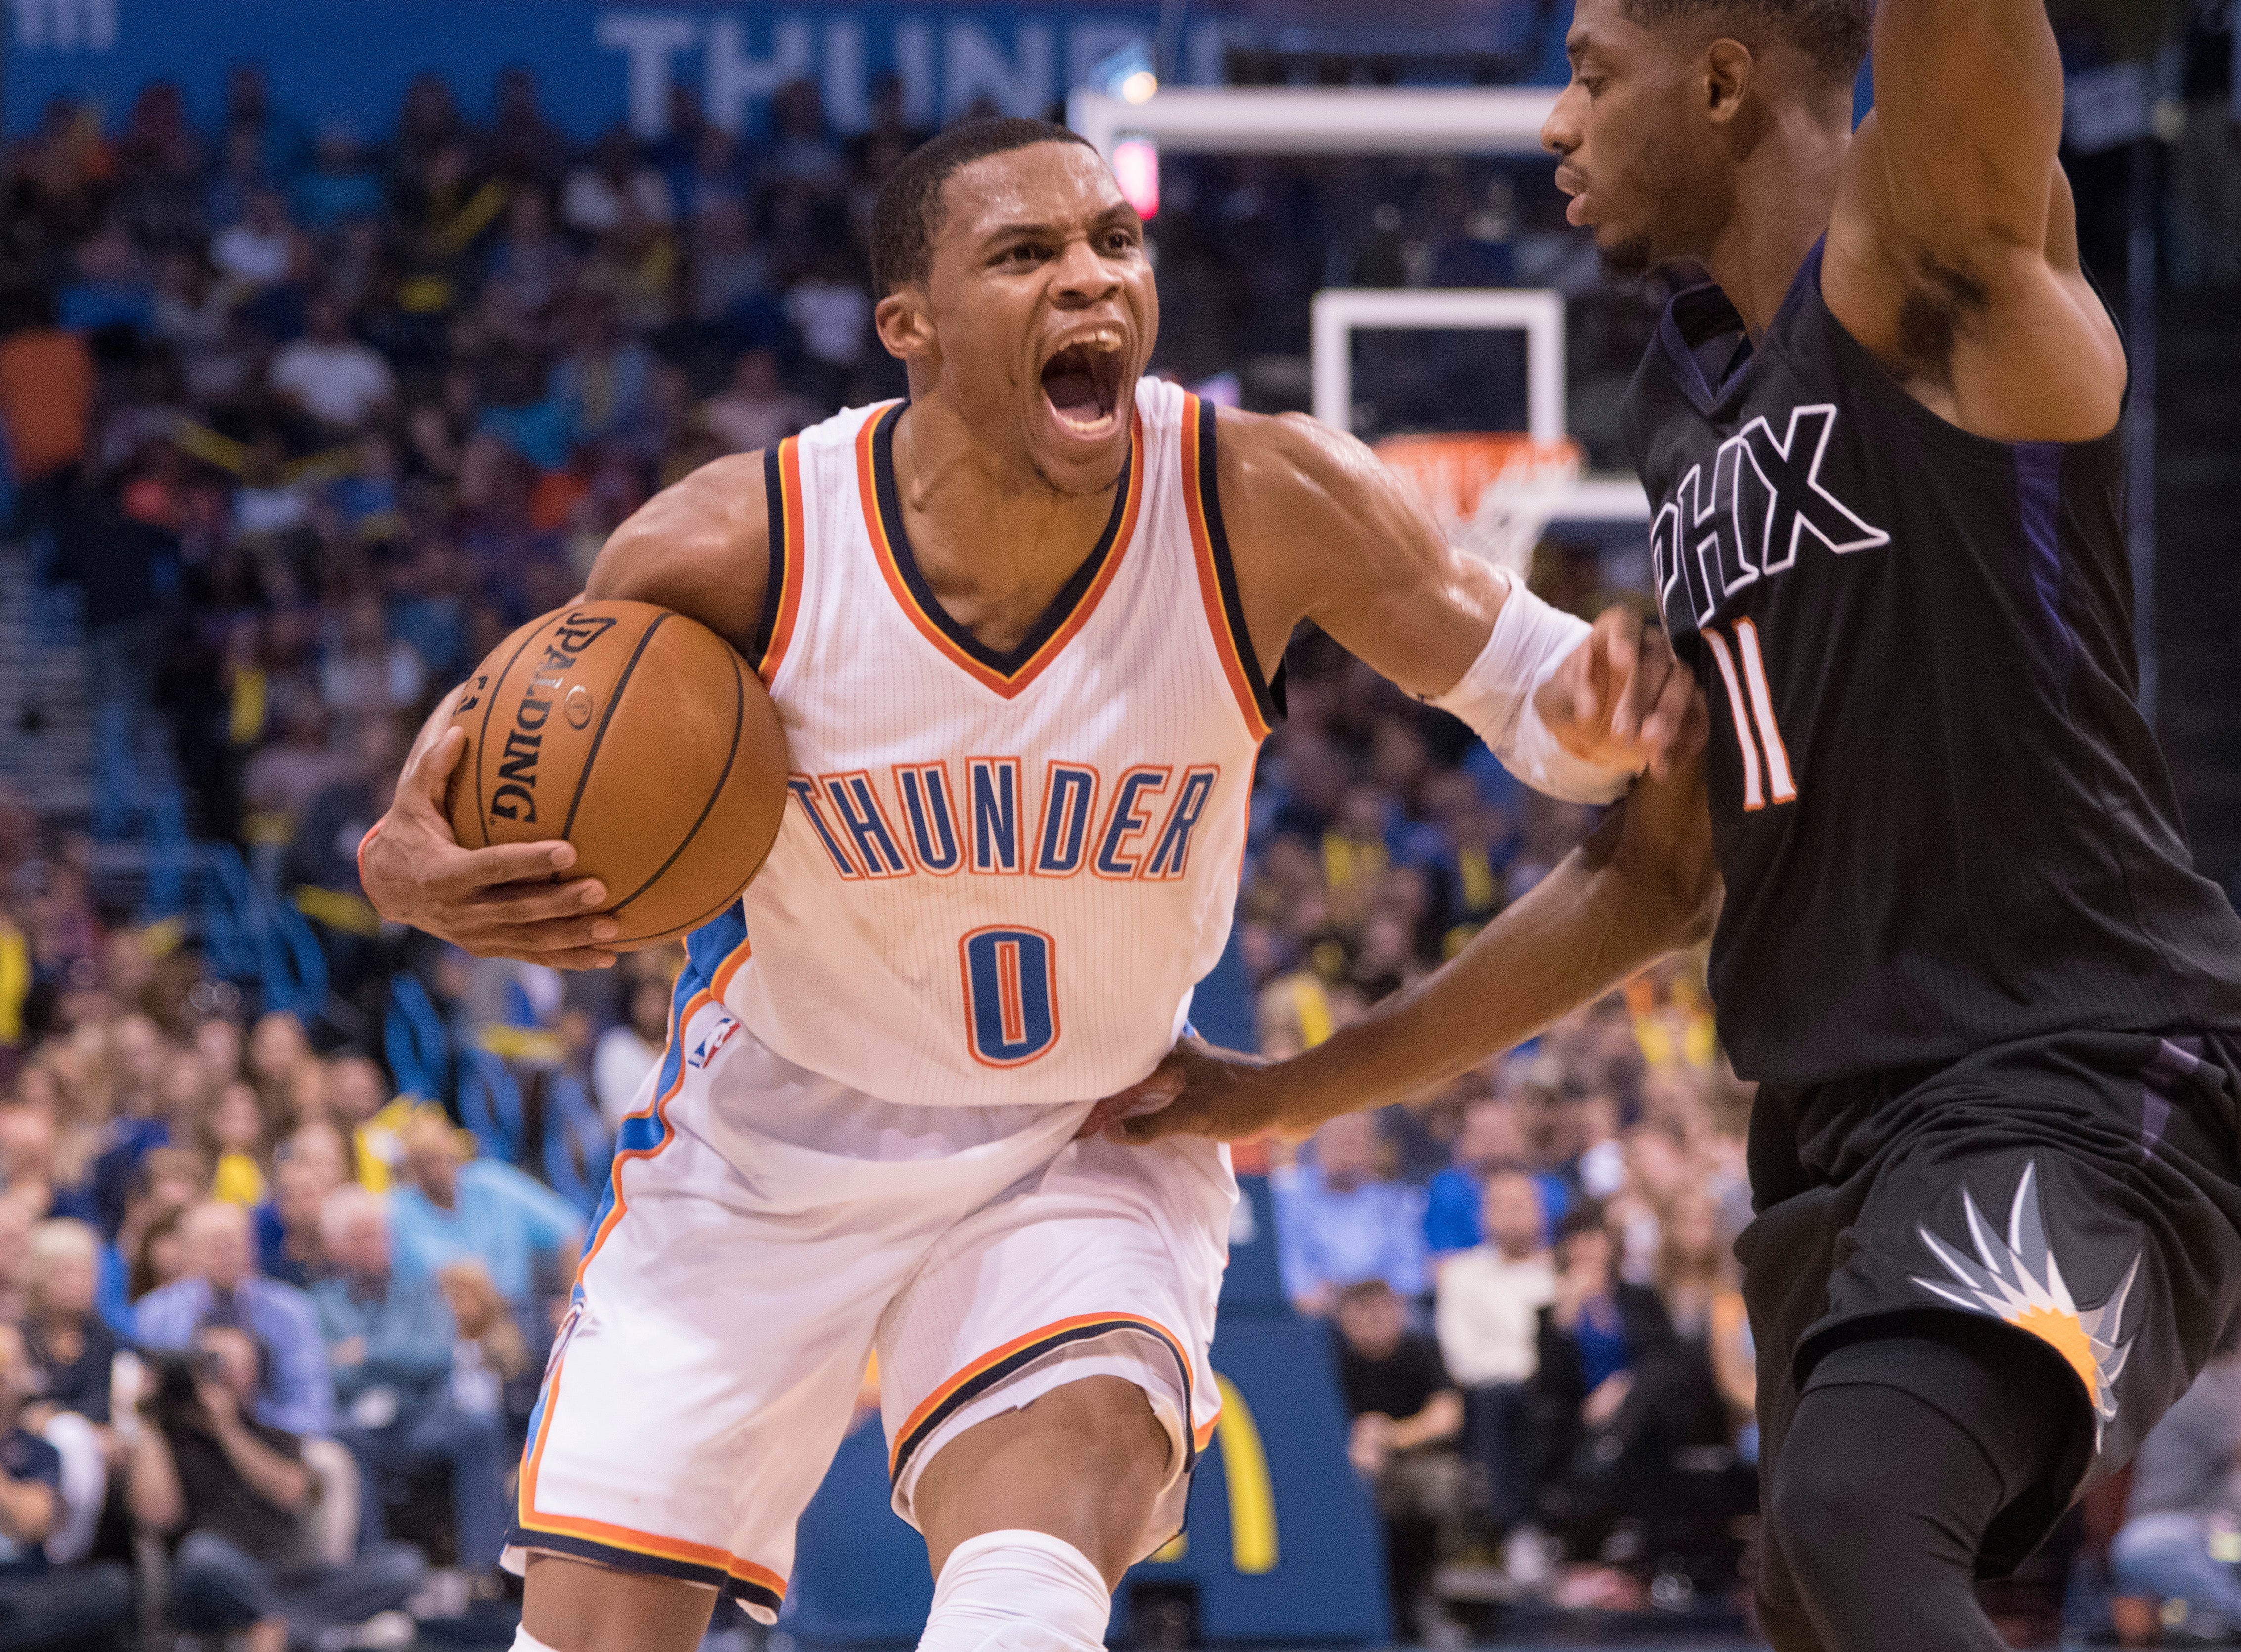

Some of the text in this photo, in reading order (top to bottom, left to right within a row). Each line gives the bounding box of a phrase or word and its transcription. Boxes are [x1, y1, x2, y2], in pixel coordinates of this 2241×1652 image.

[491, 612, 617, 824] SPALDING
[1700, 615, 1797, 812] 11
[787, 756, 1220, 881] THUNDER
[958, 924, 1061, 1069] 0
